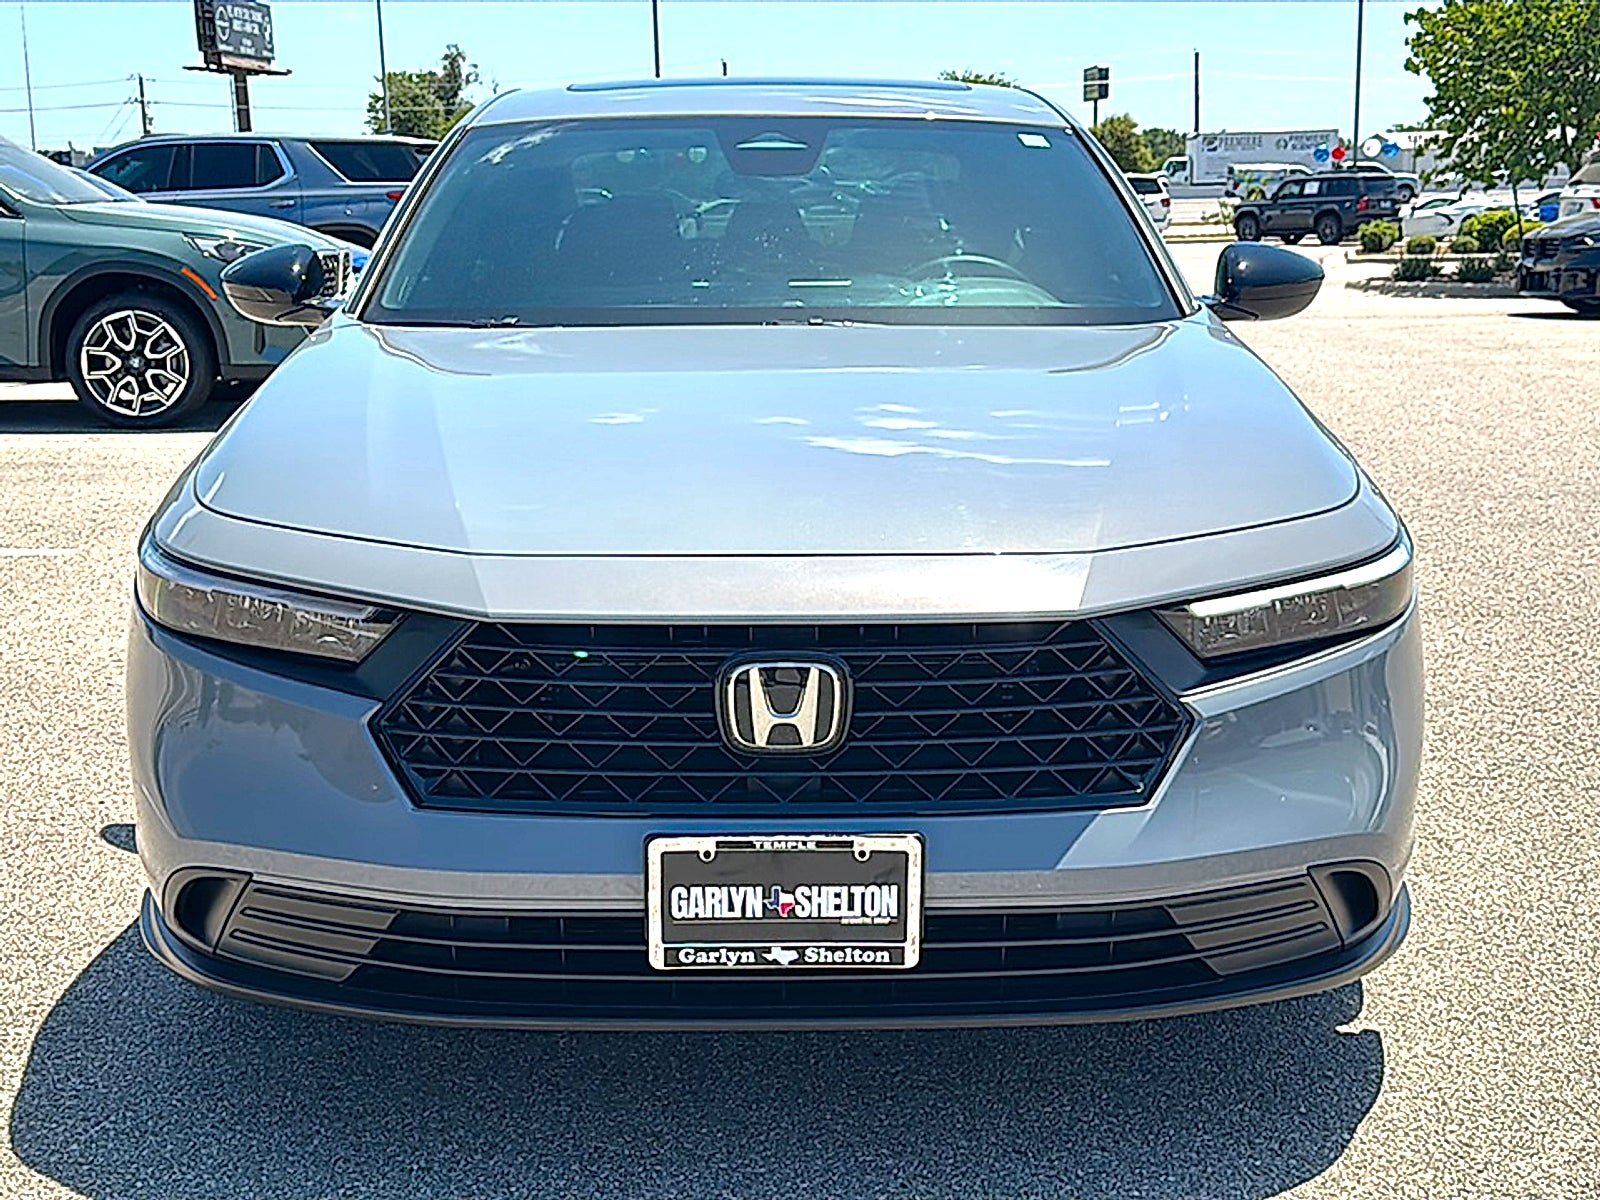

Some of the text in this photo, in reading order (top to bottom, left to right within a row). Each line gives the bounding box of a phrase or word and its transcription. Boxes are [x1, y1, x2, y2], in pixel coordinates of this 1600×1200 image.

[753, 840, 817, 850] TEMPLE
[670, 884, 899, 919] GARLYN SHELTON
[678, 947, 890, 967] Garlyn Shelton
